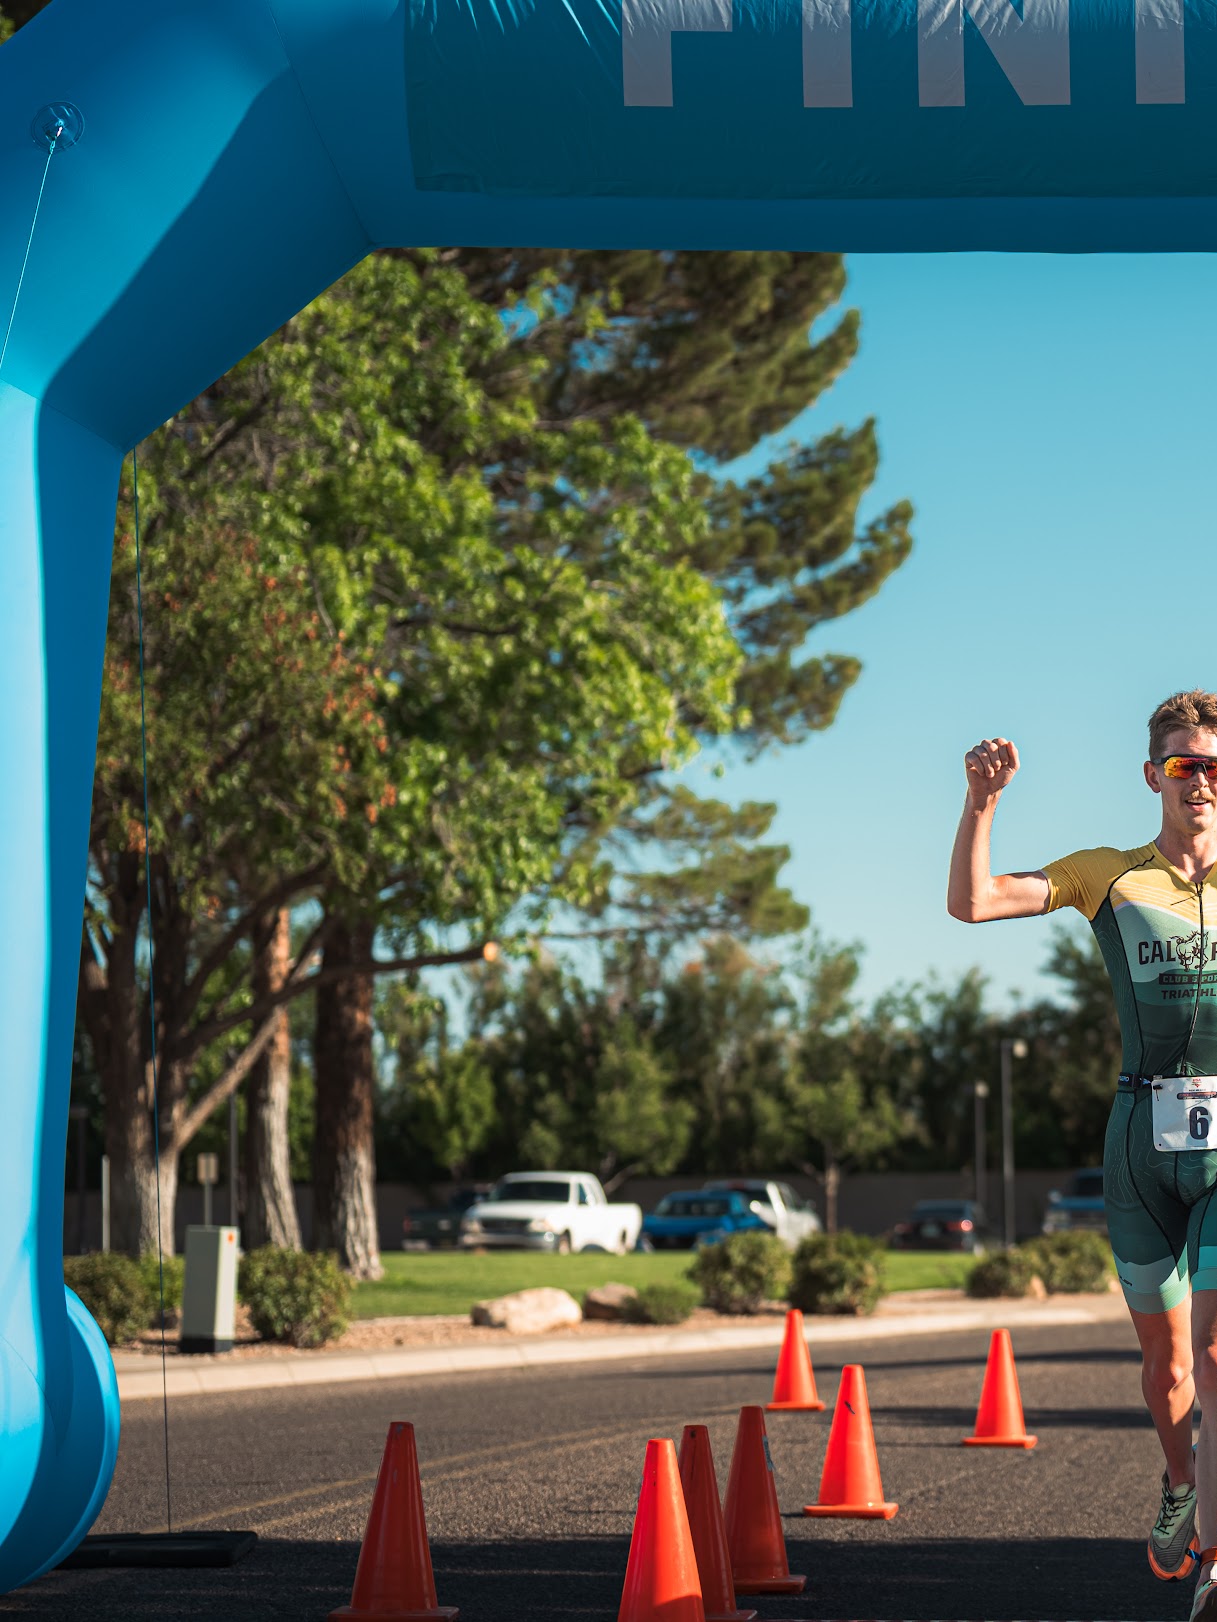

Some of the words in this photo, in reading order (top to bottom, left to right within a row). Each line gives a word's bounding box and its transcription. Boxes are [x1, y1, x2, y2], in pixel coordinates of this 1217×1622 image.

[1138, 939, 1177, 965] CAL
[1163, 975, 1188, 983] CLUB
[1189, 1106, 1209, 1140] 6
